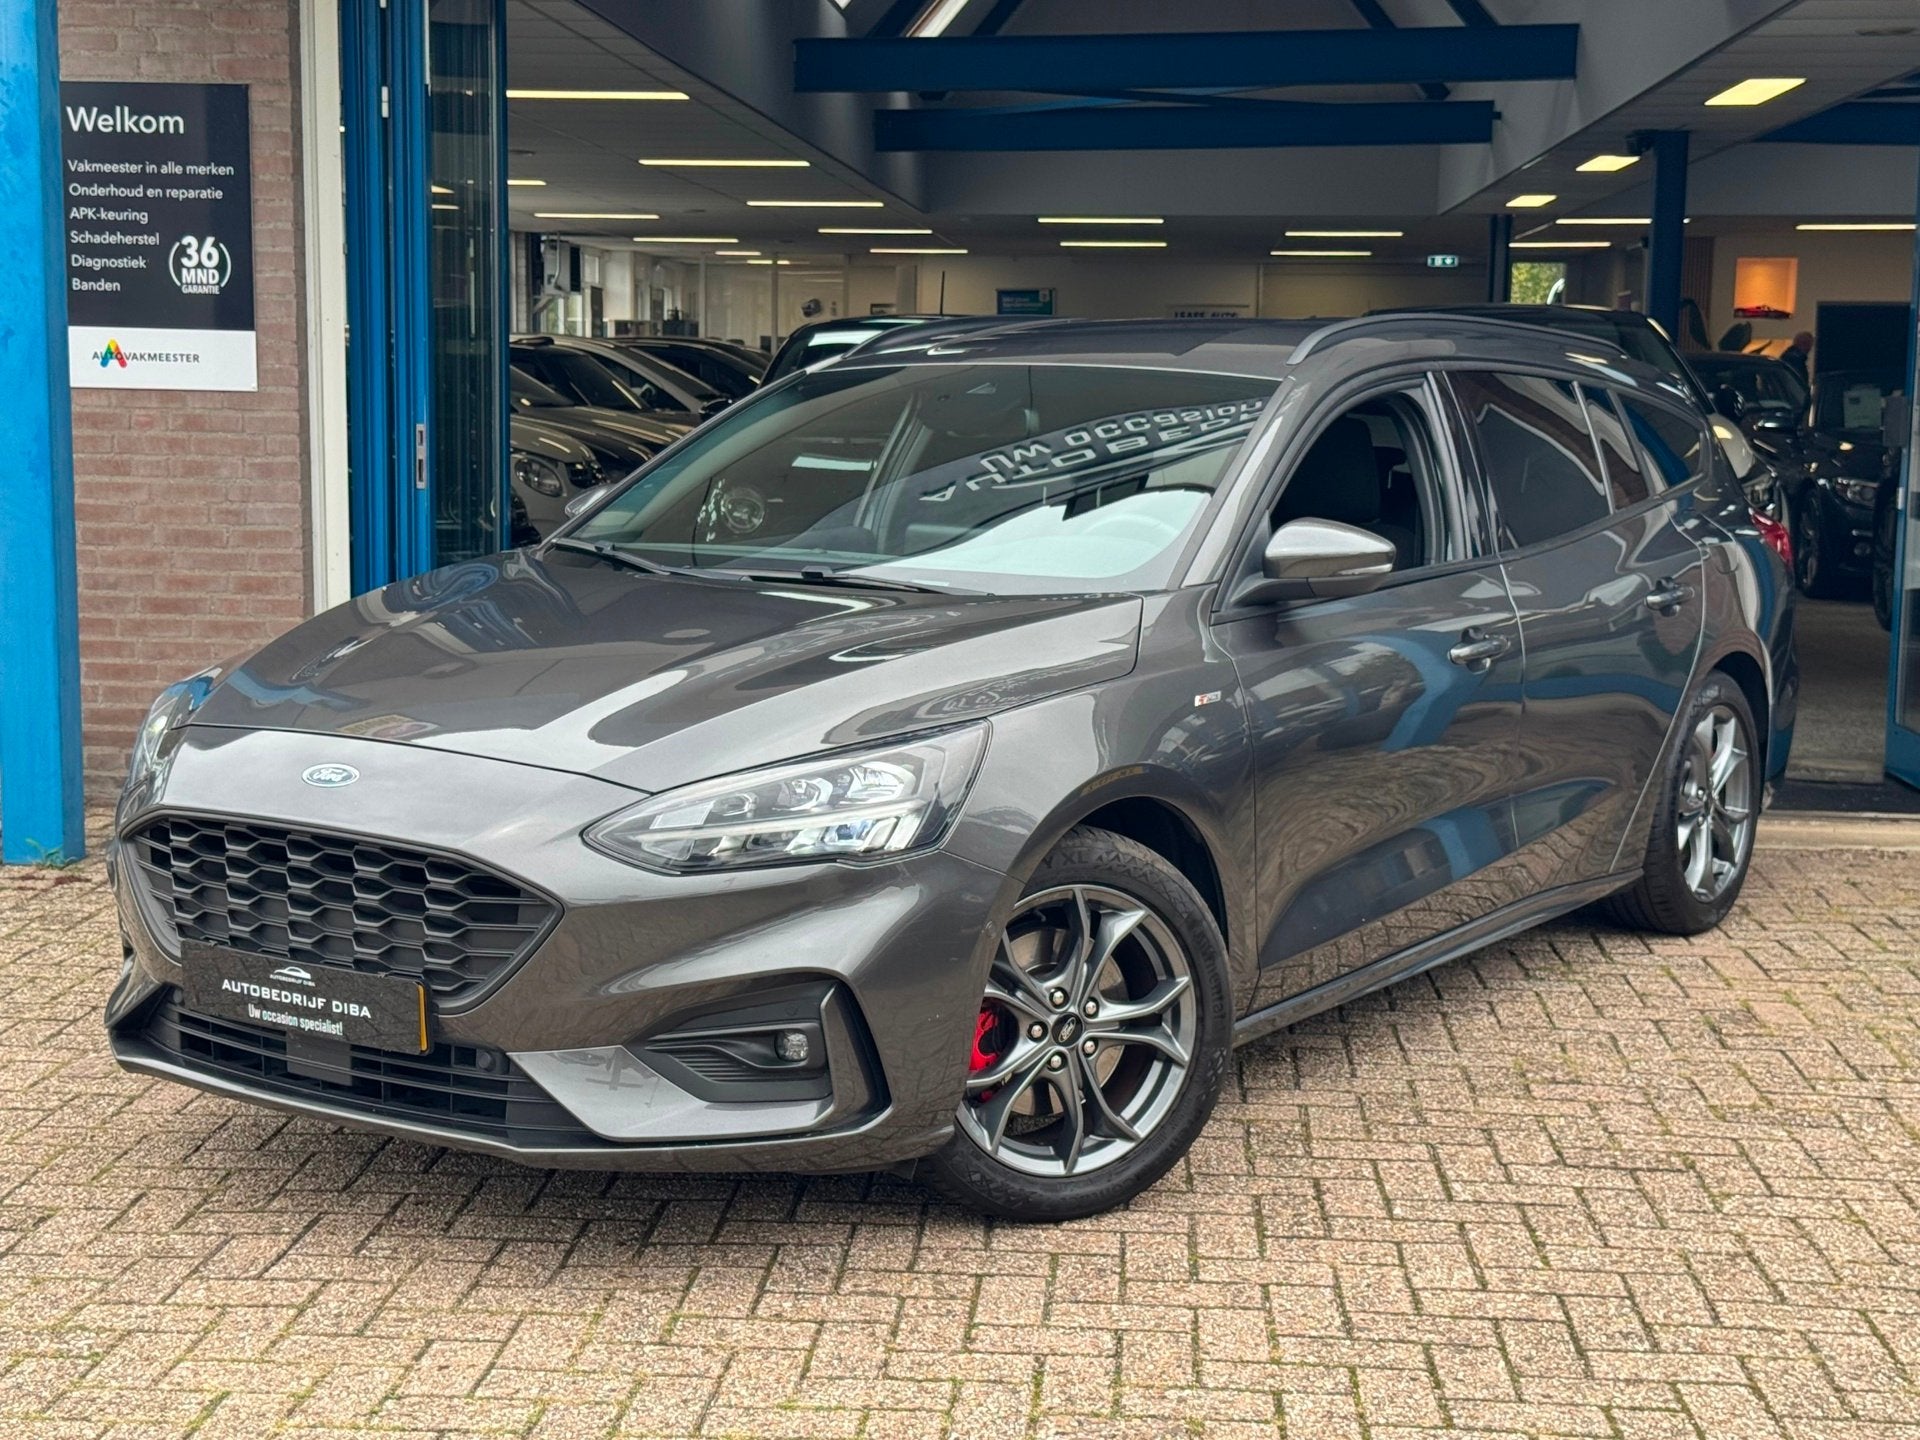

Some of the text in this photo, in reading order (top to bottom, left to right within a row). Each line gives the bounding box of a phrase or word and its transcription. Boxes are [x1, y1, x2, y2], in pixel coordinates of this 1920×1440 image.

[66, 105, 185, 134] Welkom
[67, 159, 234, 176] Vakmeester in alle merken
[69, 183, 223, 201] Onderhoud en reparatie
[69, 207, 149, 224] APK-keuring
[70, 231, 160, 245] Schadeherstel
[180, 235, 220, 268] 36
[71, 254, 147, 270] Diagnostiek
[72, 278, 121, 291] Banden
[181, 268, 219, 285] MND
[181, 285, 220, 295] GARANTIE
[221, 979, 372, 1019] AUTOBEDRIJF DIBA
[247, 1003, 344, 1036] Uw occasion specialist!
